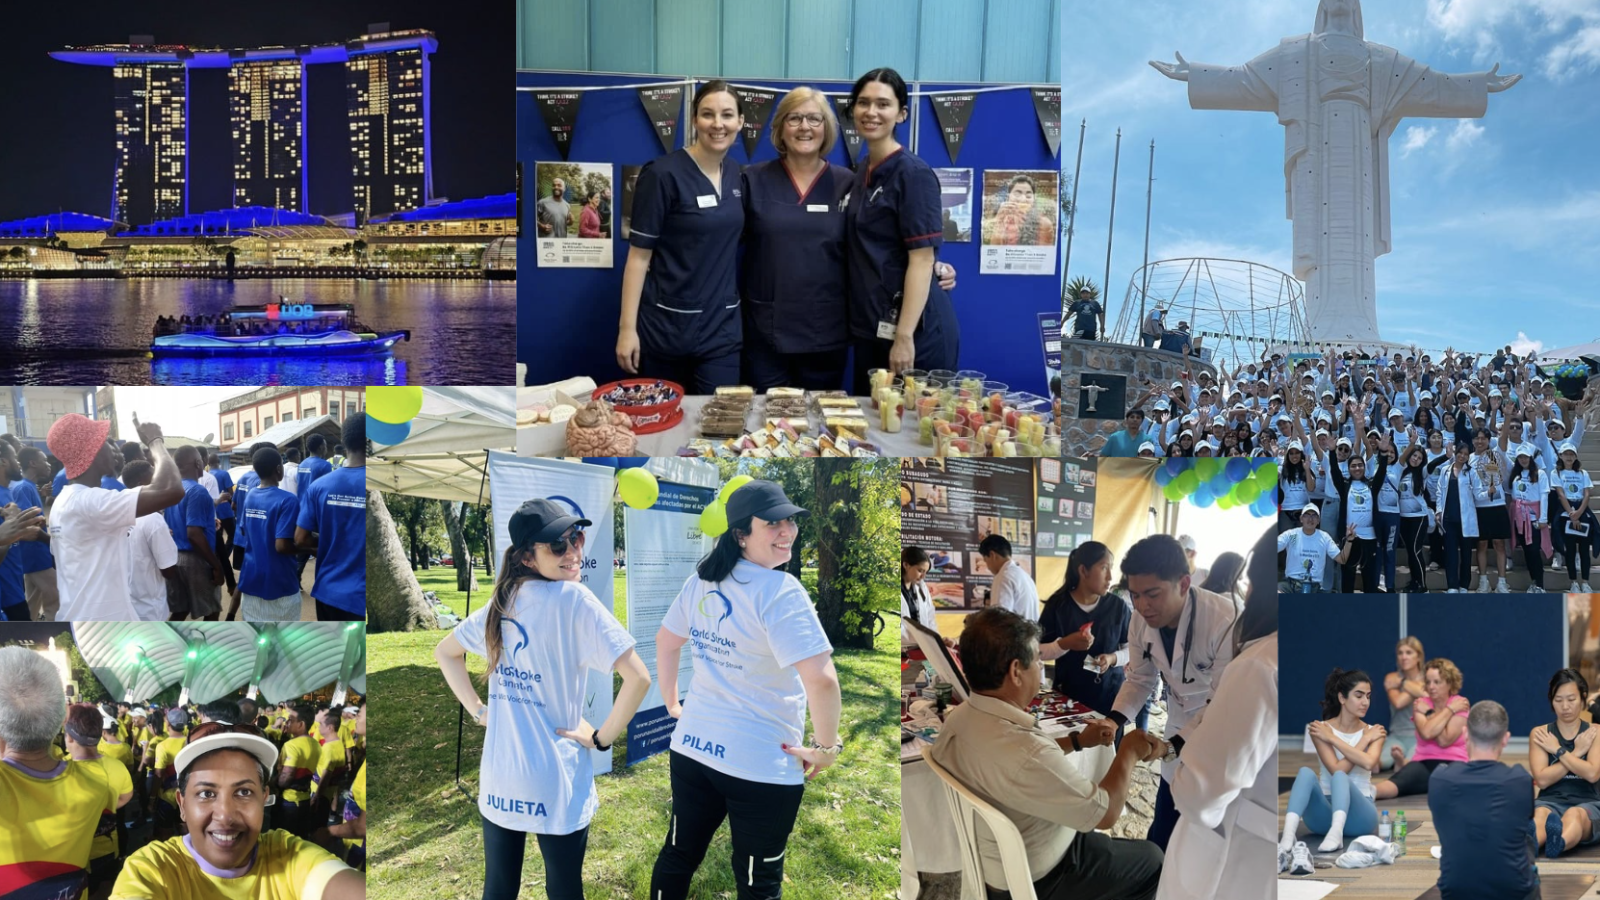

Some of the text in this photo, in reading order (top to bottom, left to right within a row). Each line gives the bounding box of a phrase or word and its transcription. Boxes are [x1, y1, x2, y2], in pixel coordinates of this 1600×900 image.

[580, 556, 597, 569] oke
[681, 733, 726, 759] PILAR
[486, 793, 548, 817] JULIETA
